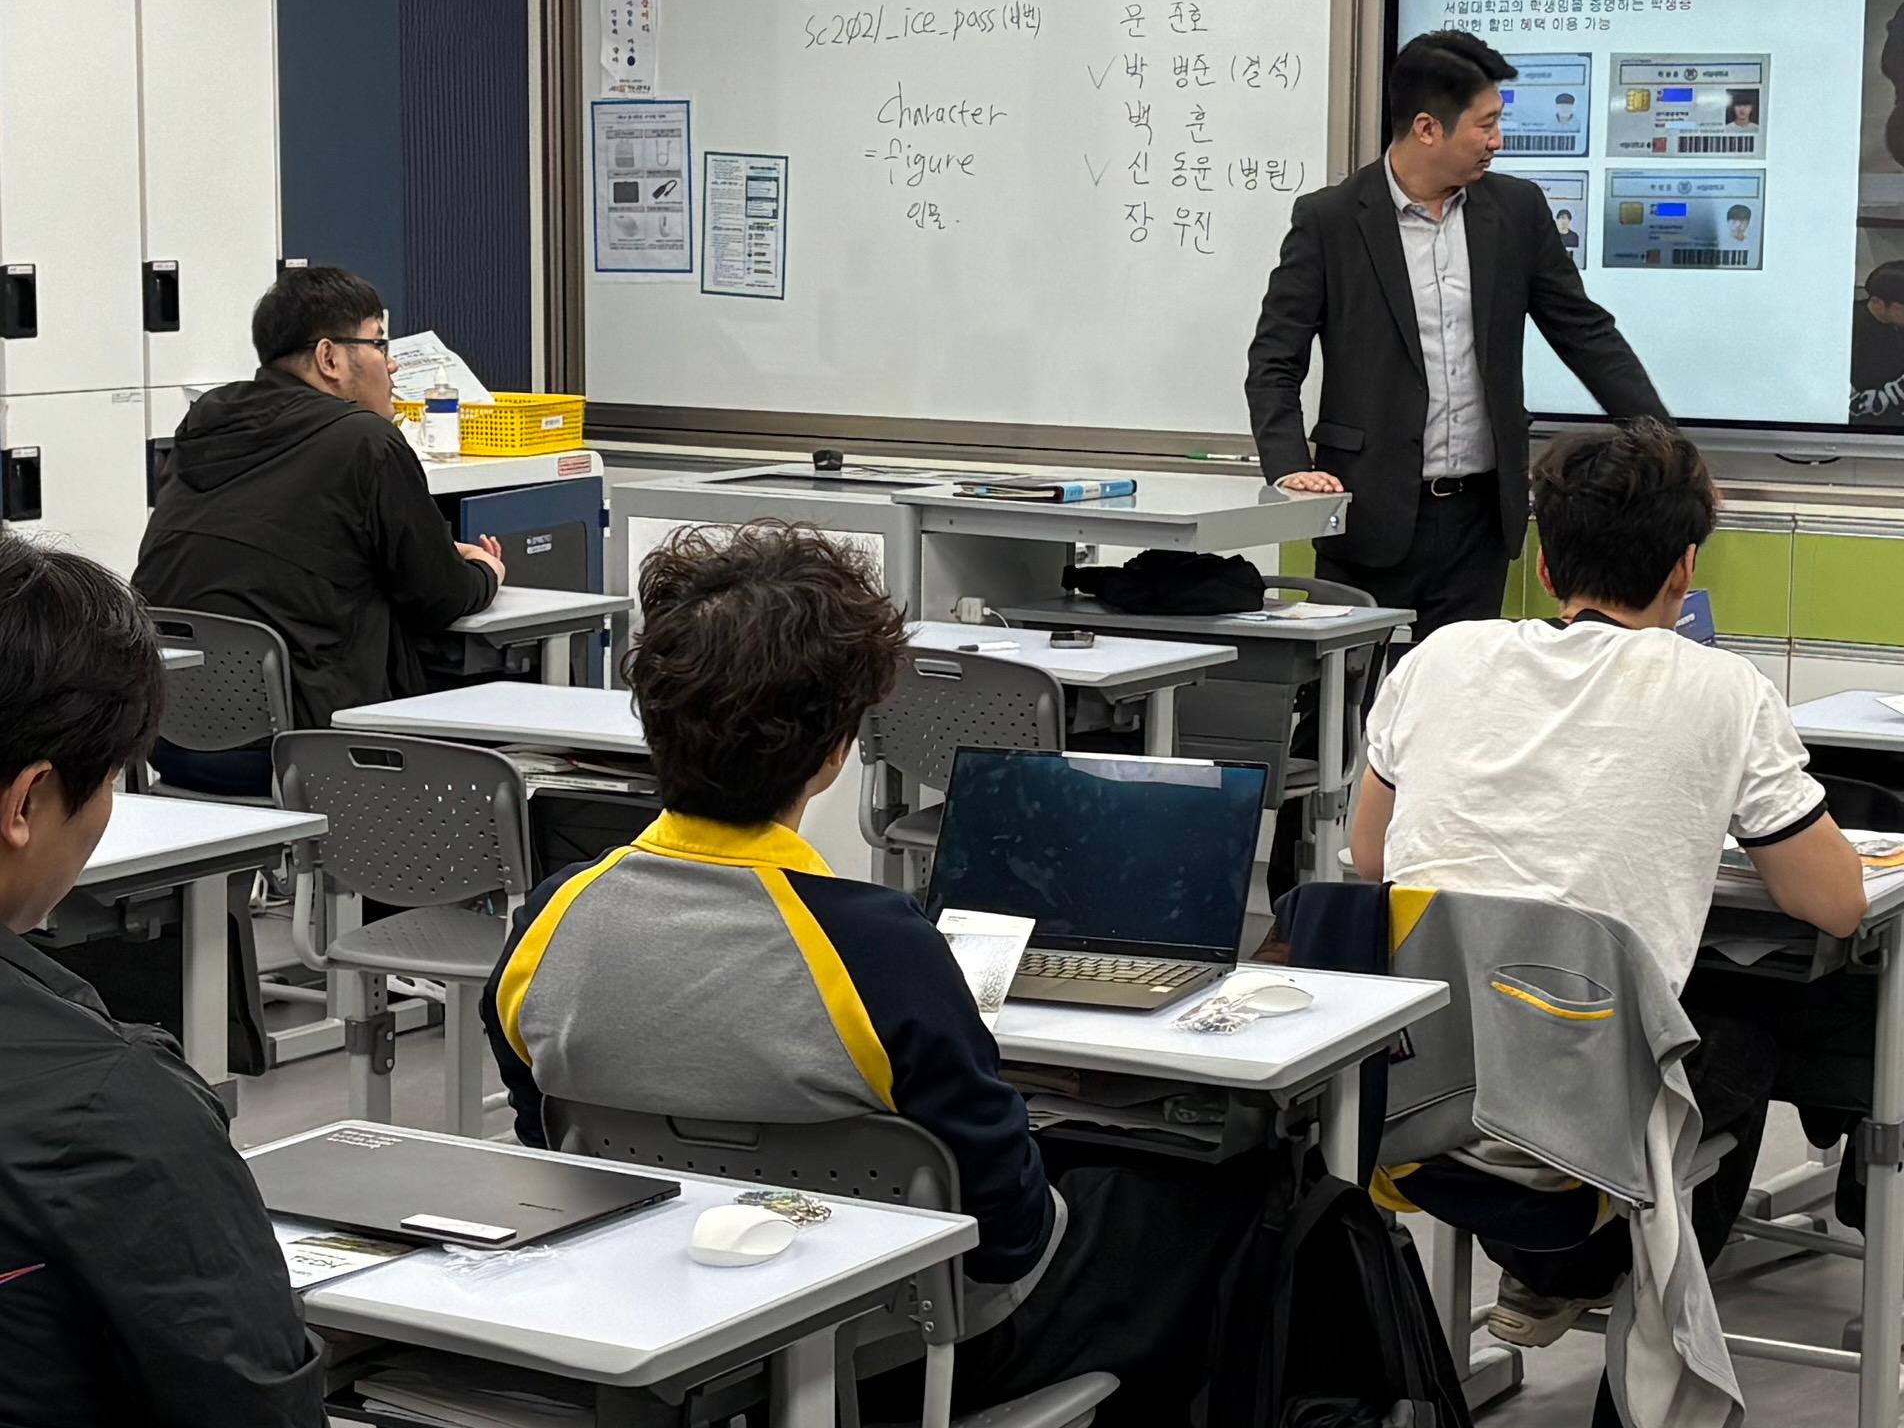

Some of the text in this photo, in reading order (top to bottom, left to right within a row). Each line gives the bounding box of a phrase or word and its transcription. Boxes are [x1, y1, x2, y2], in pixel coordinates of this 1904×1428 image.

[1120, 1, 1209, 38] 문 준호
[1552, 17, 1578, 31] 이용
[1584, 17, 1611, 31] 가능
[1124, 52, 1302, 92] 박 병준 (결석)
[1124, 99, 1214, 146] 백 훈
[1128, 150, 1150, 185] 신
[1228, 156, 1305, 194] (병원)
[1124, 201, 1216, 255] 장 우진
